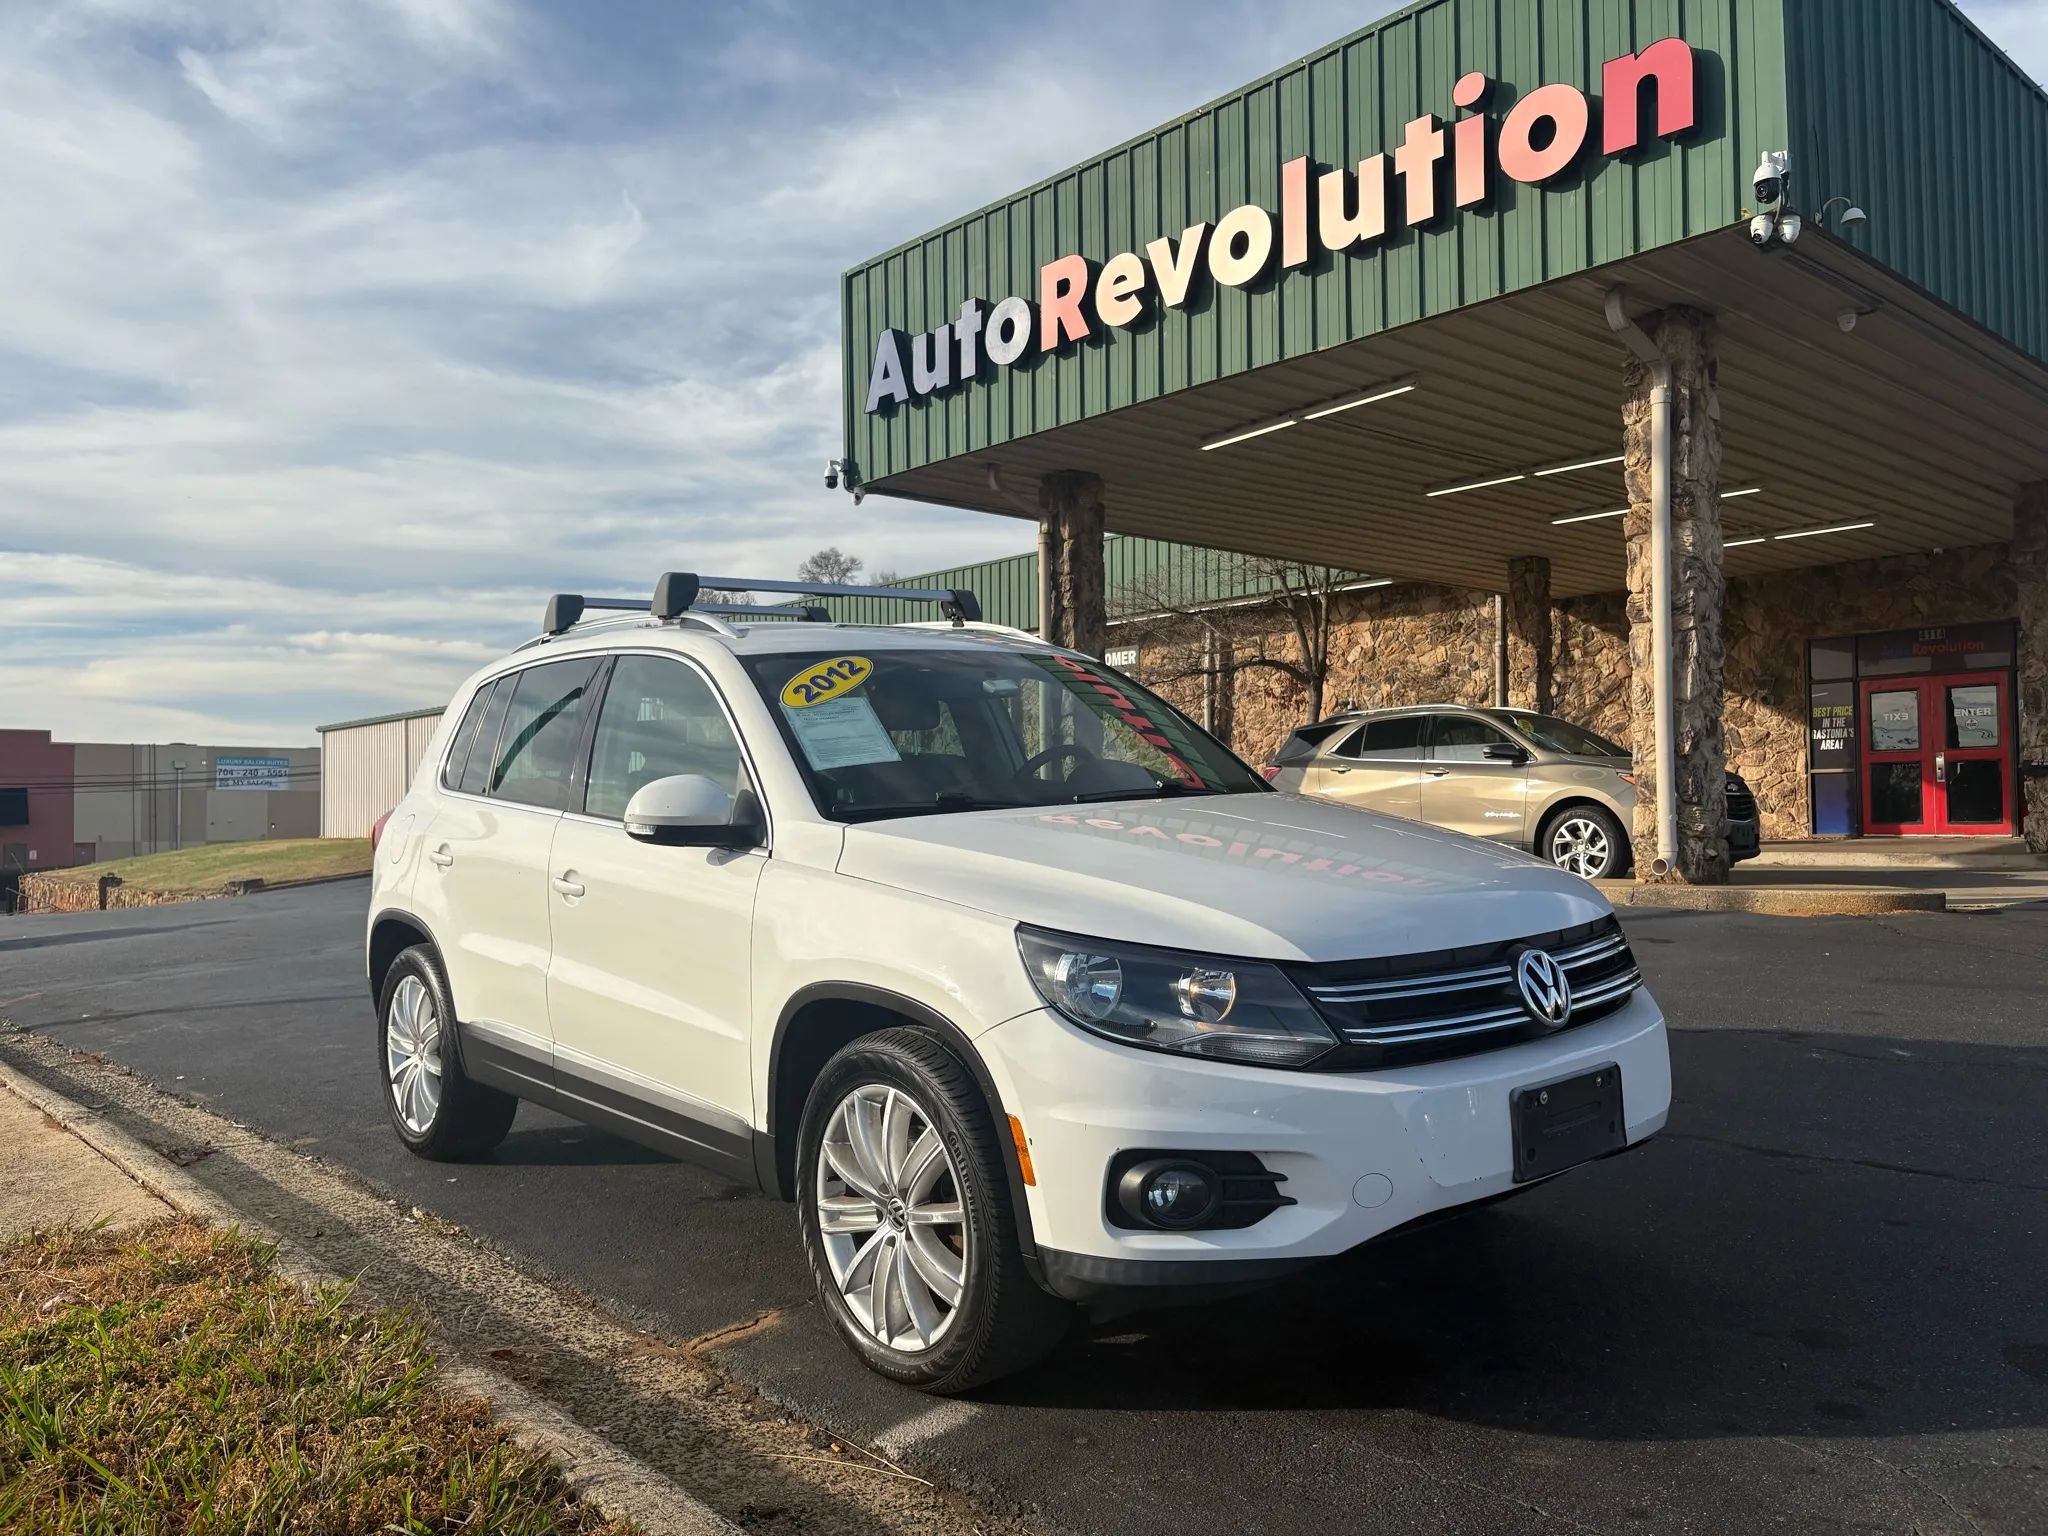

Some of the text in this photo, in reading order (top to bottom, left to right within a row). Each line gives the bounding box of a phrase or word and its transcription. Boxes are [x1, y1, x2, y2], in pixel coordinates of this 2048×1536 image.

[792, 660, 865, 703] 2012
[1812, 705, 1853, 717] BEST PRICE
[1954, 707, 1992, 717] ENTER
[1822, 717, 1846, 728] IN THE
[1820, 739, 1844, 750] AREA!
